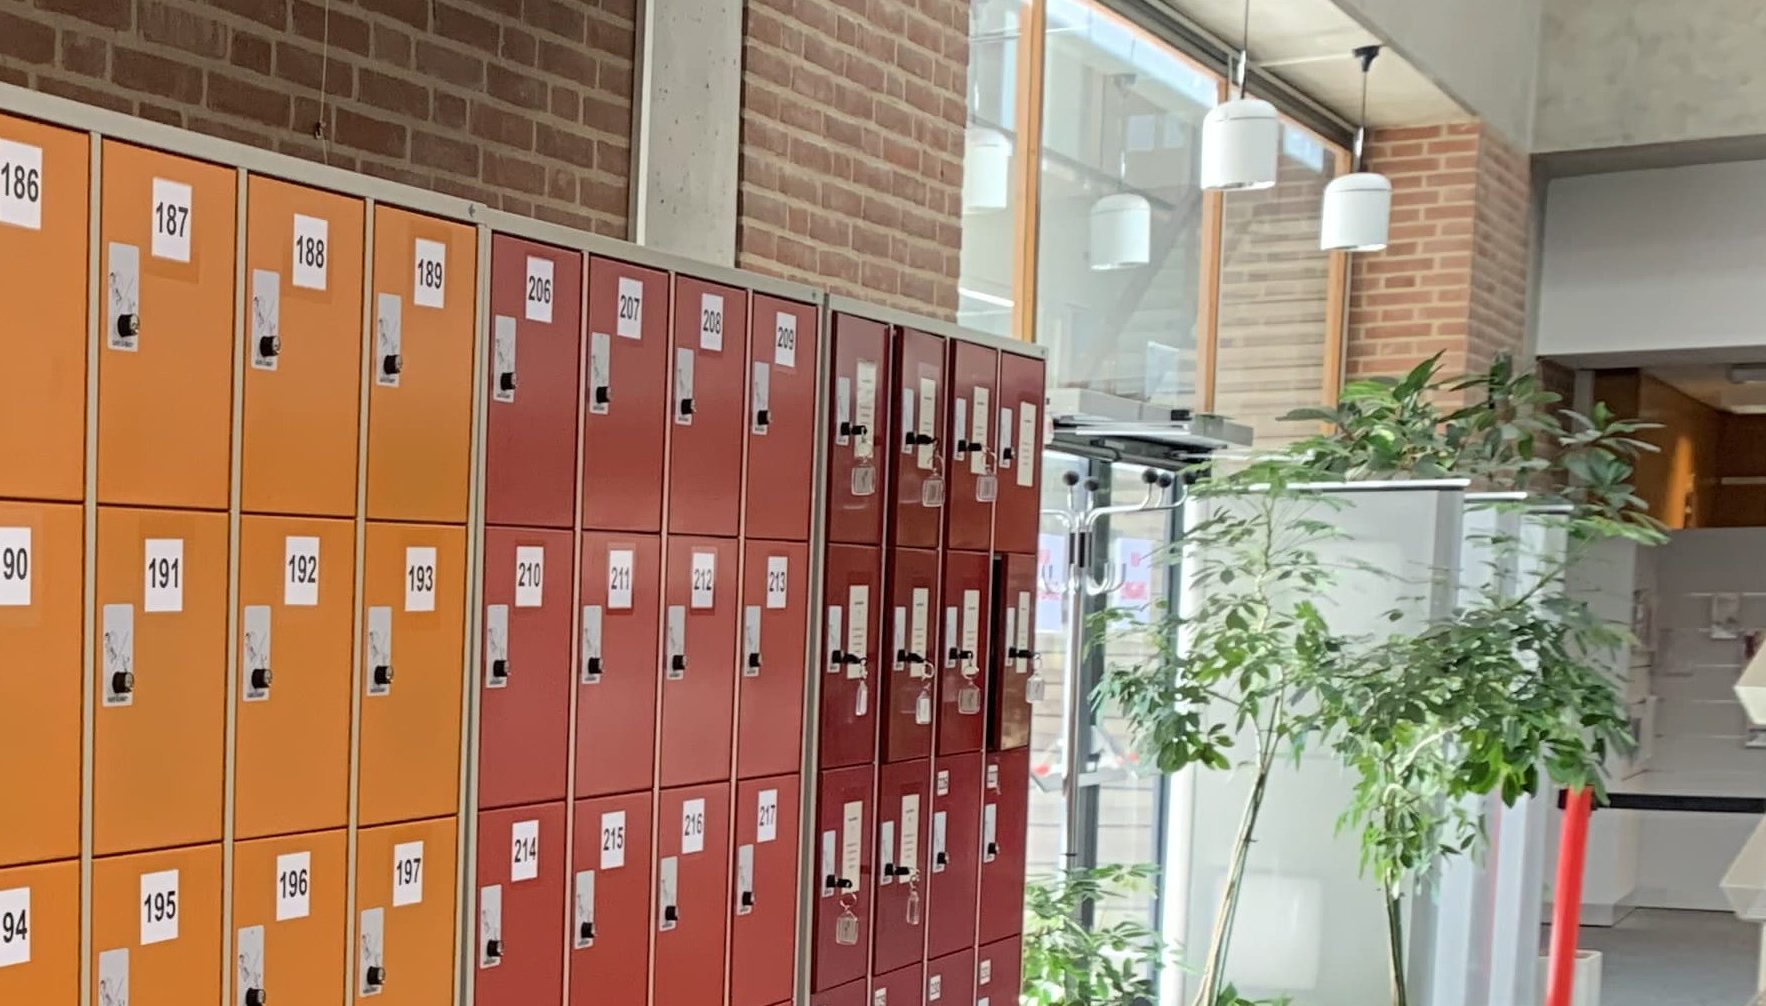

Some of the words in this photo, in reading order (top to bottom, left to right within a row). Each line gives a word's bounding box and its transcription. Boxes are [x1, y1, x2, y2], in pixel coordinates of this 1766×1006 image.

[1, 162, 39, 203] 186
[156, 201, 189, 238] 187
[296, 235, 325, 269] 188
[417, 259, 443, 290] 189
[528, 275, 551, 304] 206
[619, 294, 640, 320] 207
[703, 309, 721, 334] 208
[777, 326, 794, 350] 209
[148, 558, 179, 589] 191
[288, 554, 317, 584] 192
[408, 565, 433, 592] 193
[518, 562, 541, 587] 210
[610, 567, 630, 590] 211
[694, 568, 712, 591] 212
[769, 571, 785, 592] 213
[684, 812, 702, 837] 216
[759, 803, 776, 827] 217
[514, 837, 537, 863] 214
[603, 826, 623, 851] 215
[279, 868, 308, 899] 196
[396, 857, 422, 886] 197
[144, 890, 176, 923] 195
